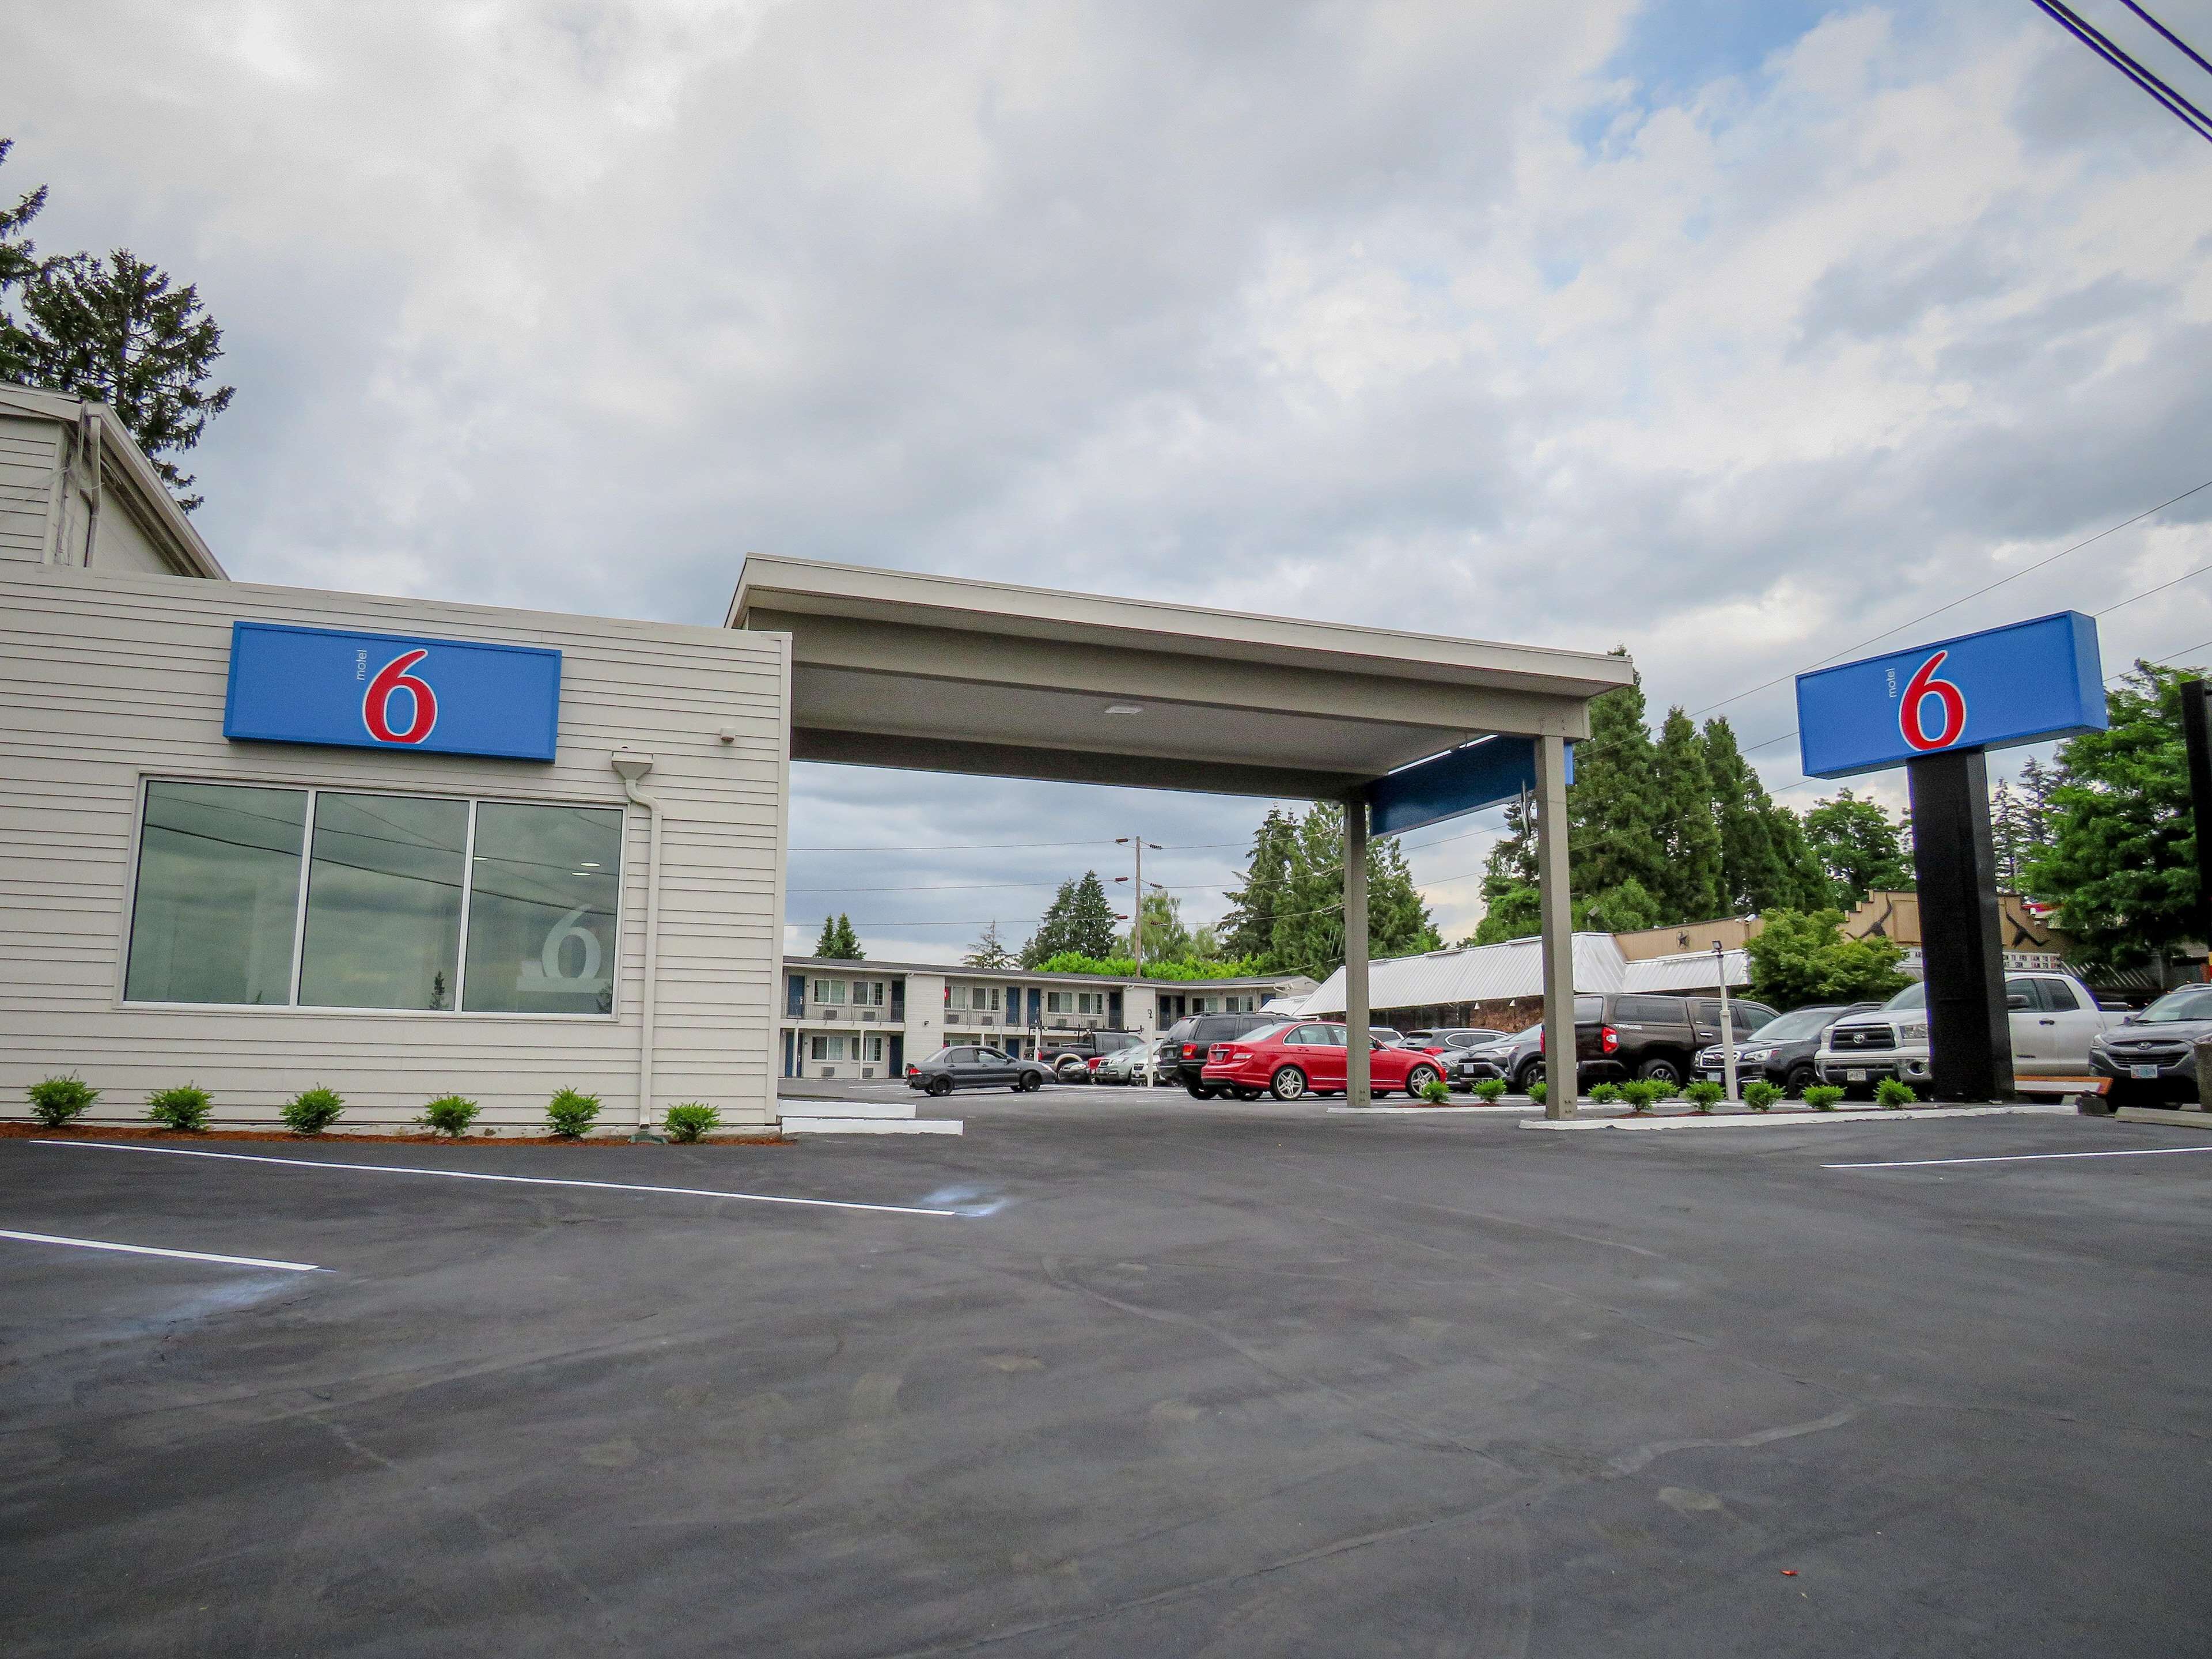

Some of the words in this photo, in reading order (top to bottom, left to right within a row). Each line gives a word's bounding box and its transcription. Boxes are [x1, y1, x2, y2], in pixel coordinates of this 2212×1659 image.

[356, 649, 367, 680] motel
[362, 648, 438, 744] 6
[1885, 668, 1897, 698] motel
[1899, 650, 1966, 751] 6
[542, 904, 601, 979] 6
